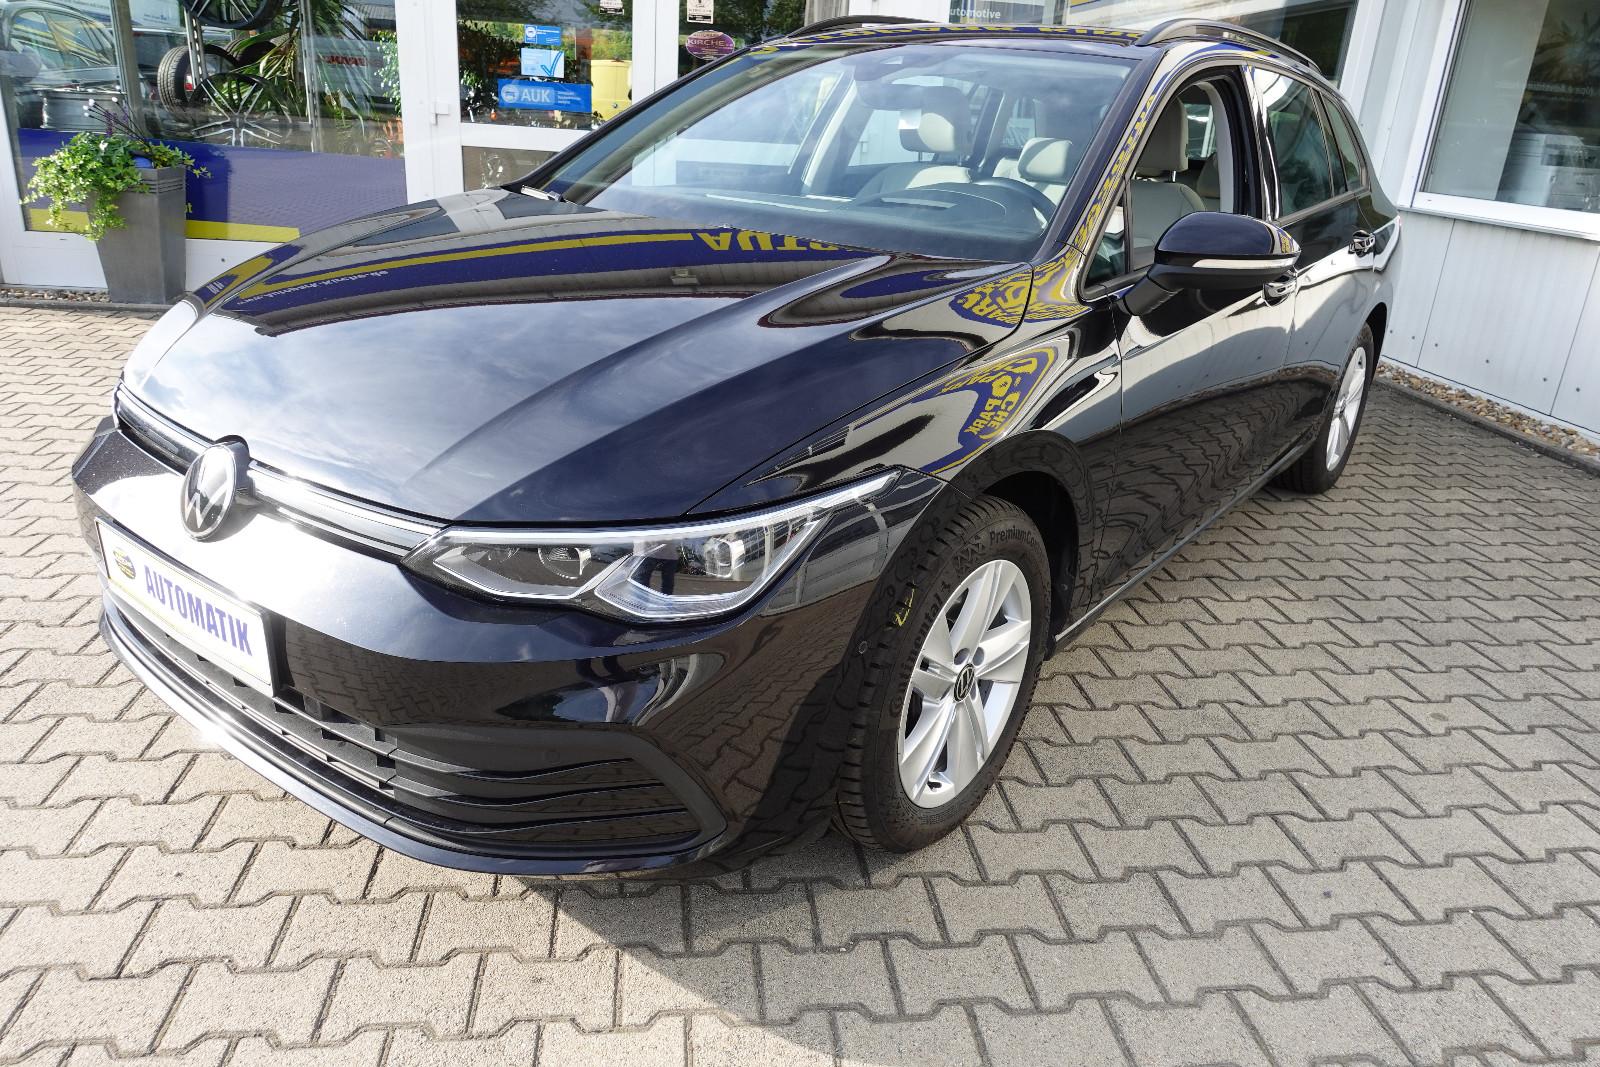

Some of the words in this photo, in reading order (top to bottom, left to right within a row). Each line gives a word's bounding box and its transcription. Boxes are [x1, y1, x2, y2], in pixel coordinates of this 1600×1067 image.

[950, 8, 1001, 19] utomotive
[689, 39, 725, 47] KIRCHE
[520, 89, 551, 103] AUK
[144, 564, 253, 656] AUTOMATIK
